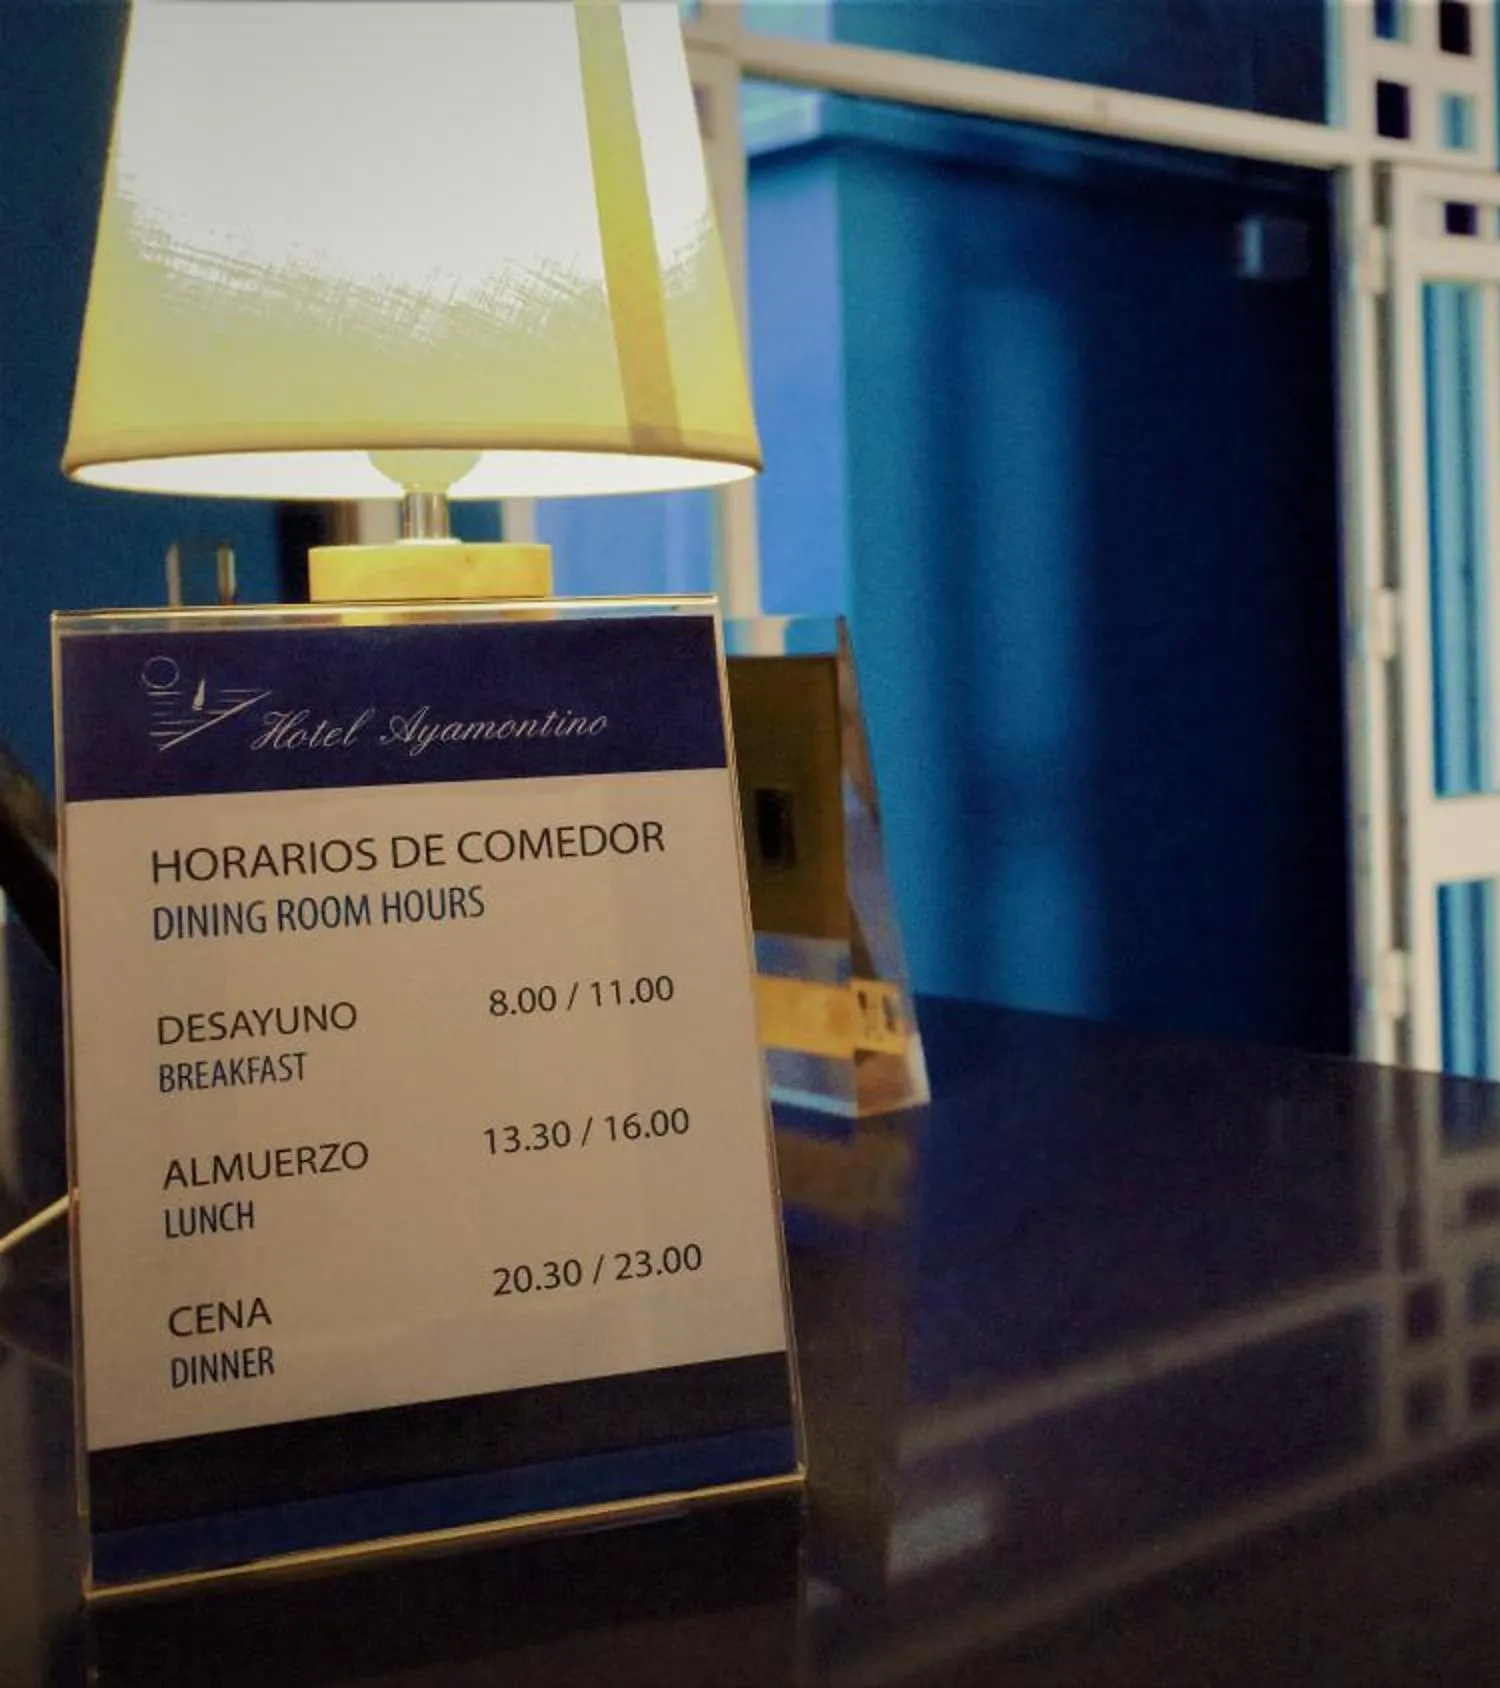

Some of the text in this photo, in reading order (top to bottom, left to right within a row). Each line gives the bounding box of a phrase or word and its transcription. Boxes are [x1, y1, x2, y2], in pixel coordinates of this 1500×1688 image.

[251, 706, 609, 758] Hotel Ayamontino
[152, 821, 667, 886] HORARIOS DE COMEDOR
[154, 885, 486, 943] DINING ROOM HOURS
[158, 976, 676, 1047] DESAYUNO 8.00 / 11.00
[159, 1052, 308, 1095] BREAKFAST
[163, 1108, 691, 1192] ALMUERZO 13.30 / 16.00
[165, 1201, 256, 1241] LUNCH
[168, 1244, 704, 1339] CENA 20.30 / 23.00
[171, 1347, 276, 1391] DINNER
